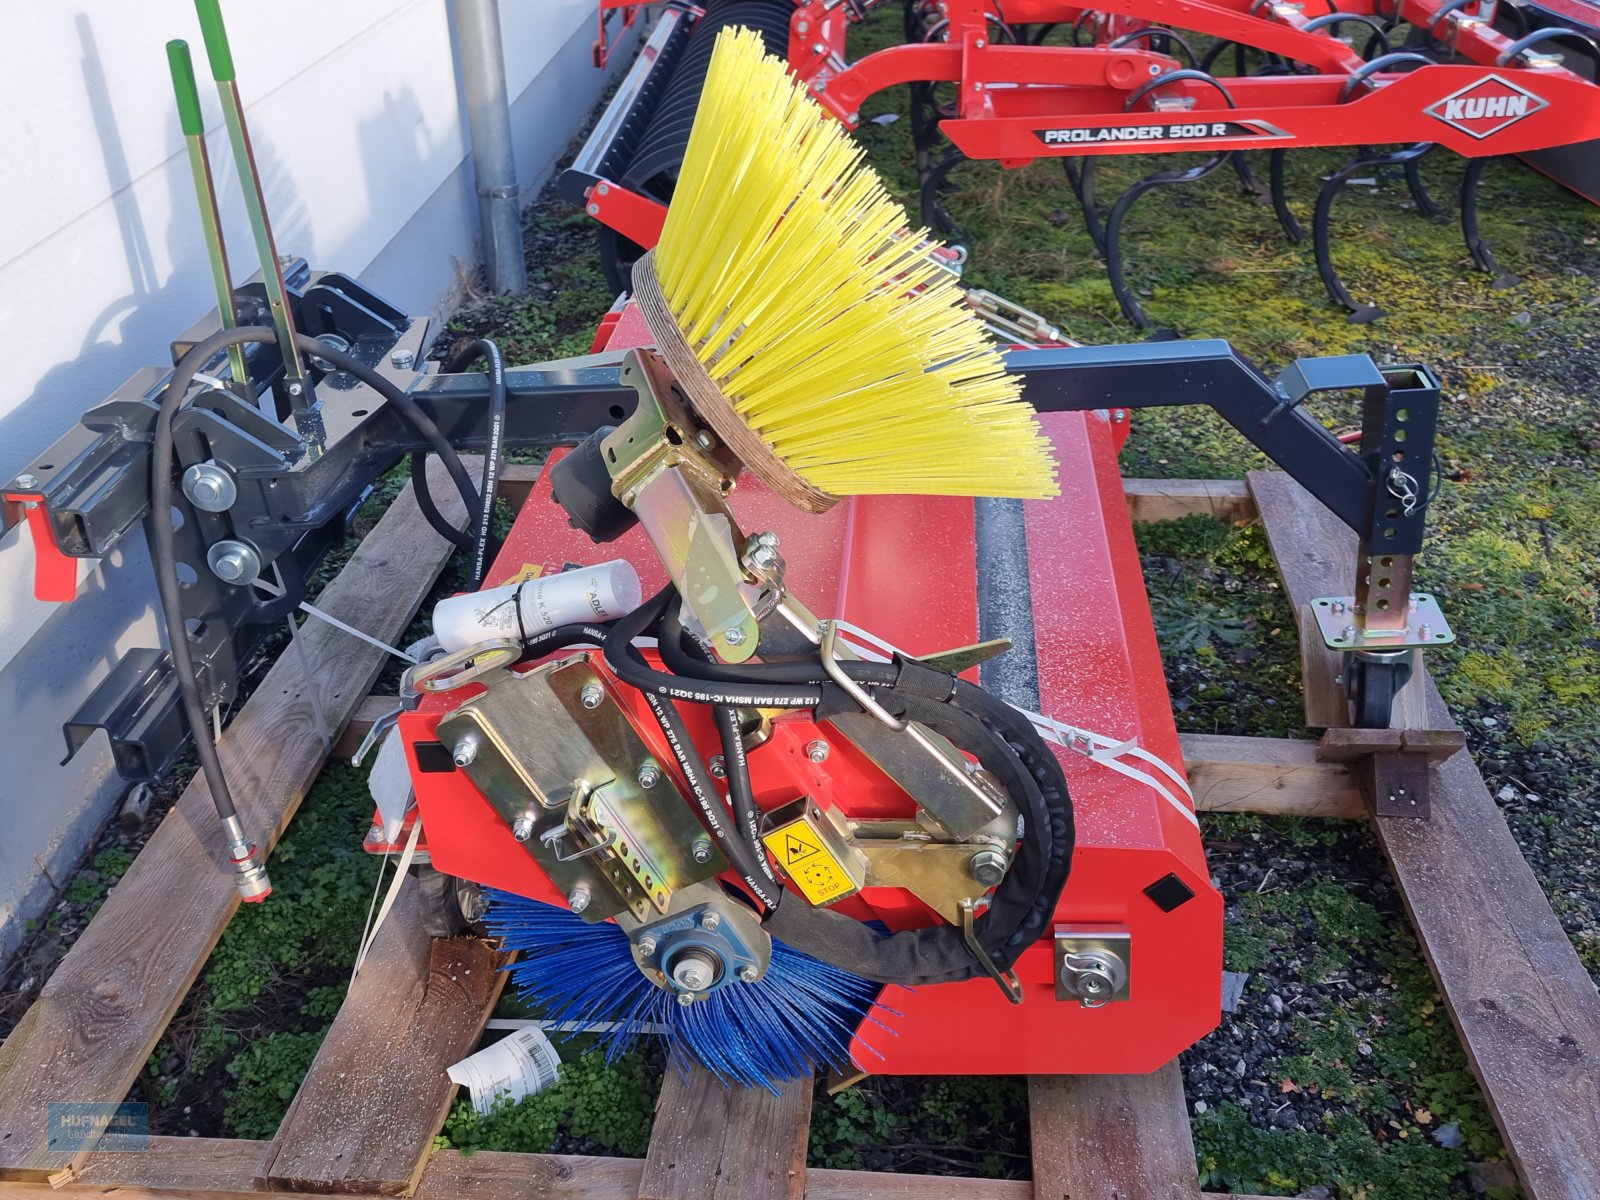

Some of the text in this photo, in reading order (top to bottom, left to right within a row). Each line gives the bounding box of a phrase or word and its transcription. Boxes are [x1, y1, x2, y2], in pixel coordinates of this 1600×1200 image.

[1444, 95, 1528, 121] KUHN
[1044, 122, 1227, 143] PROLANDER 500 R
[475, 538, 486, 580] HANSA-FLEX
[541, 611, 553, 626] 520
[582, 627, 608, 641] HANSA-F
[669, 688, 693, 699] 3Q21
[694, 692, 723, 703] IC-195
[725, 696, 753, 705] MSHA
[753, 697, 773, 705] BAR
[774, 697, 789, 705] 275
[790, 697, 804, 705] WP
[804, 697, 815, 705] 12
[728, 708, 746, 767] HANSA-FLEX
[655, 706, 664, 716] 12
[660, 716, 671, 729] WP
[667, 729, 678, 744] 275
[673, 743, 686, 762] BAR
[682, 761, 698, 786] MSHA
[693, 785, 710, 810] IC-195
[705, 809, 721, 829] 3Q21
[744, 875, 777, 910] HANSA-FLE
[817, 882, 841, 897] STOP
